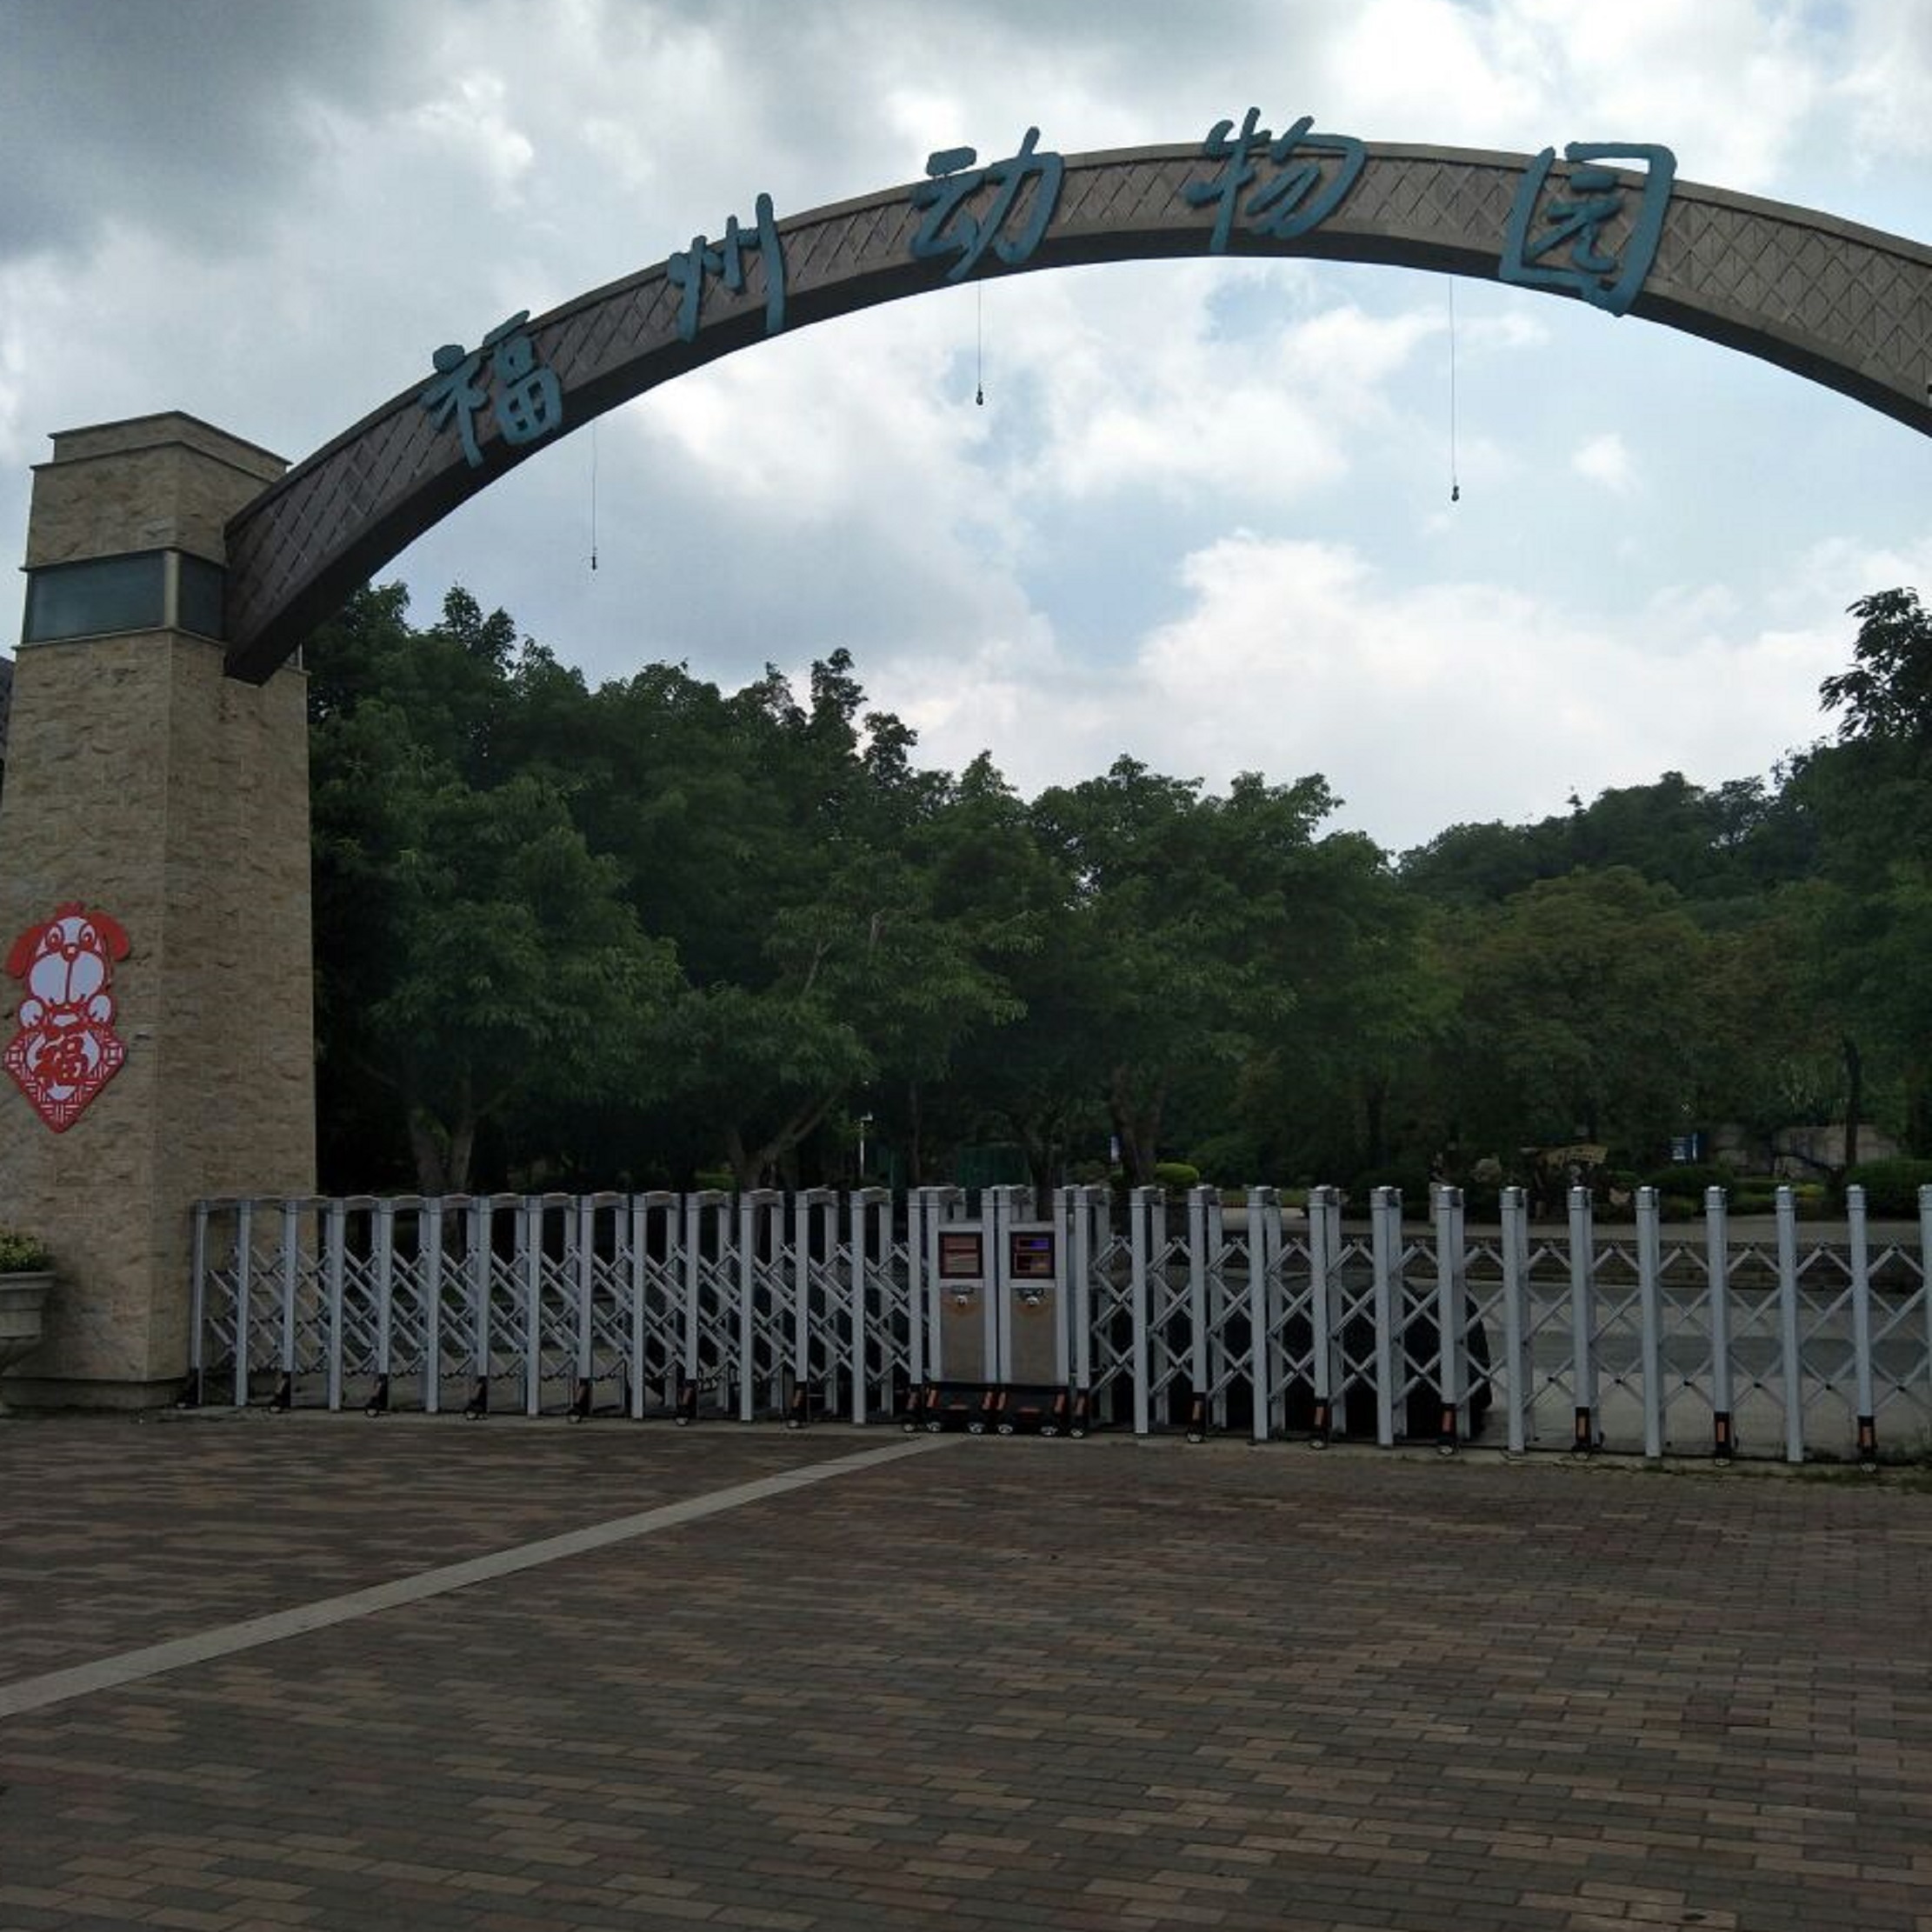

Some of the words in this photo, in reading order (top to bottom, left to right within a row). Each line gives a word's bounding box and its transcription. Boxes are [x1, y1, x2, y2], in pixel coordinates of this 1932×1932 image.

[421, 108, 1676, 467] 福州动物园
